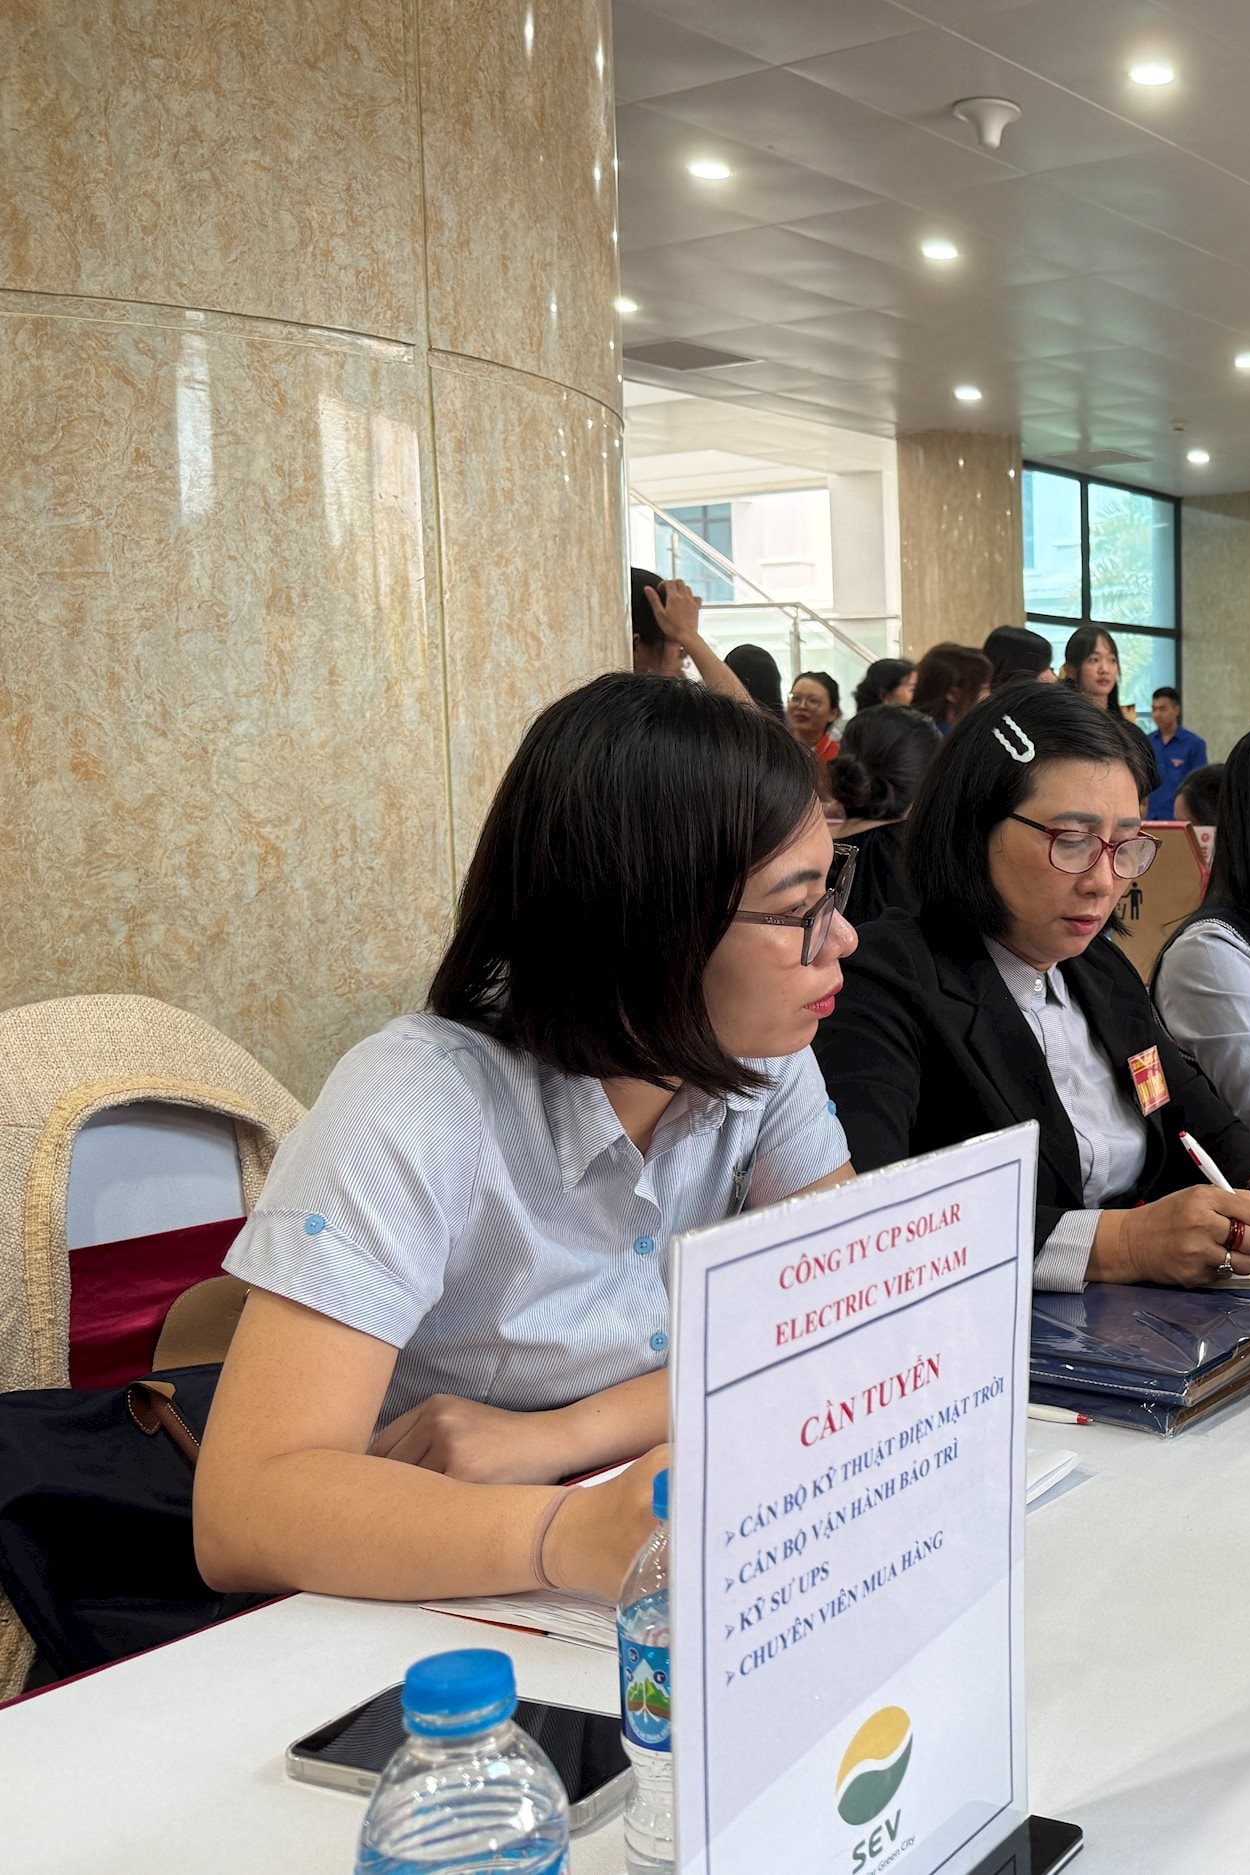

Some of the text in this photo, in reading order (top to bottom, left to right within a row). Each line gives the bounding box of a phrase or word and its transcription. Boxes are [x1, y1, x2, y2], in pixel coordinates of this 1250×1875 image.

[779, 1203, 961, 1290] CÔNG TY CP SOLAR
[775, 1284, 878, 1346] ELECTRIC
[929, 1246, 968, 1281] NAM
[800, 1352, 941, 1447] CẦN TUYỂN
[739, 1376, 1004, 1538] CÁN BỘ KỸ THUẬT ĐIỆN MẶT TRỜI
[738, 1437, 959, 1584] CÁN BỘ VẬN HÀNH BẢO TRÌ
[739, 1560, 831, 1632] KỸ SƯ UPS
[739, 1530, 943, 1676] CHUYÊN VIÊN MUA HÀNG
[852, 1808, 902, 1875] SEV
